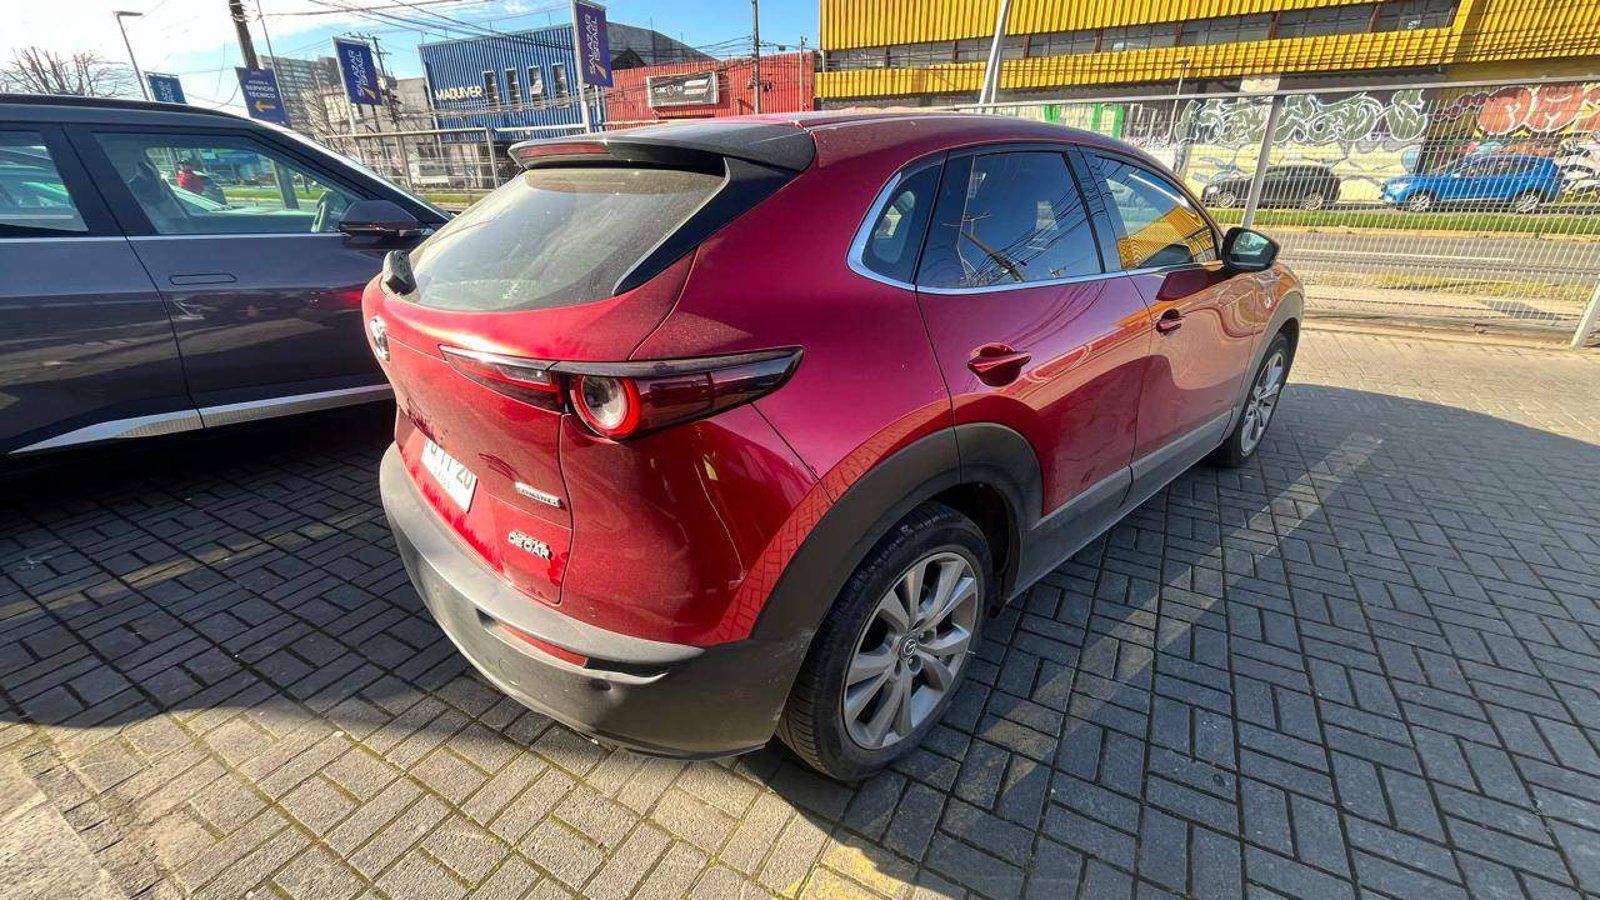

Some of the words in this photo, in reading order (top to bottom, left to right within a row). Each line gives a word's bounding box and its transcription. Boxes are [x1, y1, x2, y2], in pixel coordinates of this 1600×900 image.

[585, 13, 596, 75] SALAZAR
[591, 17, 600, 61] ISRAEL
[348, 49, 365, 97] SALAZAR
[355, 51, 368, 86] ISRAEL
